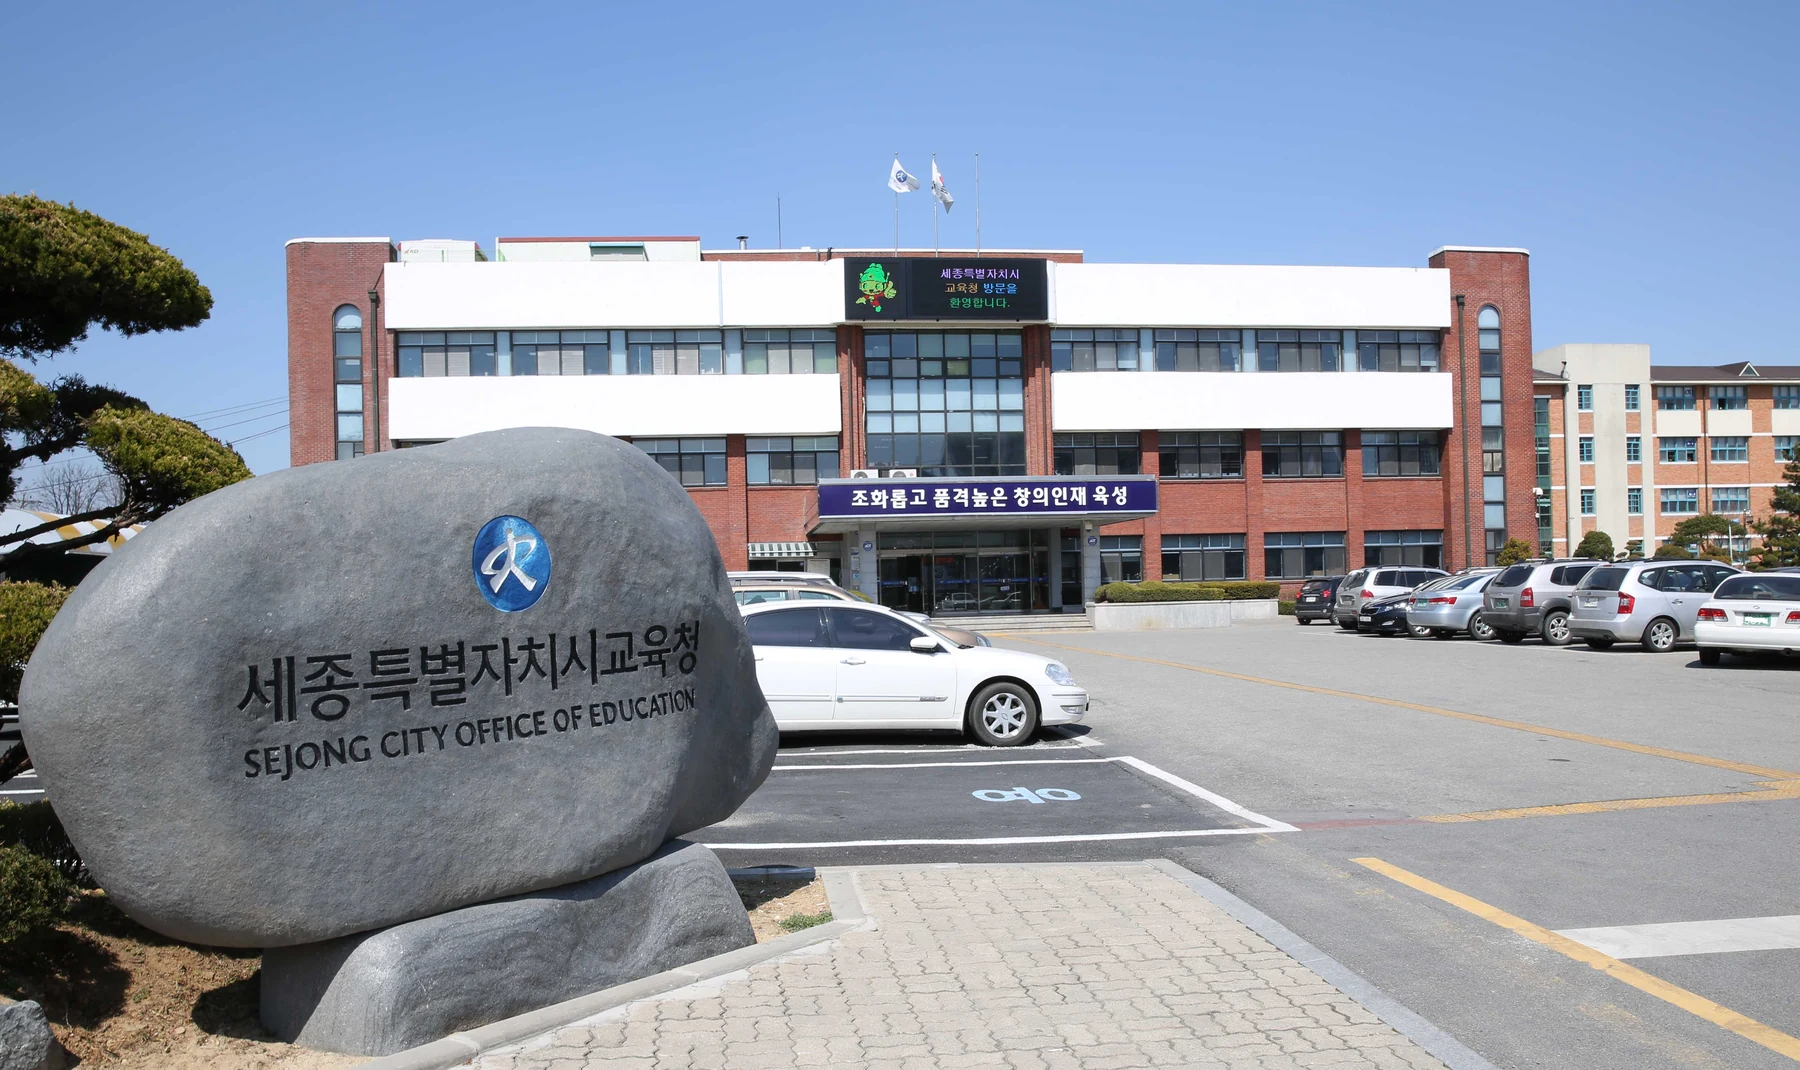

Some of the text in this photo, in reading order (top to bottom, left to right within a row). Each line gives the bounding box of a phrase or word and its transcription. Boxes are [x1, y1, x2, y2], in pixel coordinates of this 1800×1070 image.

[940, 268, 1020, 280] 세종특별자치시
[945, 282, 1018, 294] 교육청 방문을
[949, 297, 1011, 309] 환영합니다.
[851, 486, 1128, 509] 조화롭고 품격높은 창의인재 육성
[237, 620, 700, 724] 세종특별자치시교육청
[244, 688, 696, 781] SEJONG CITY OFFICE OF EDUCATION
